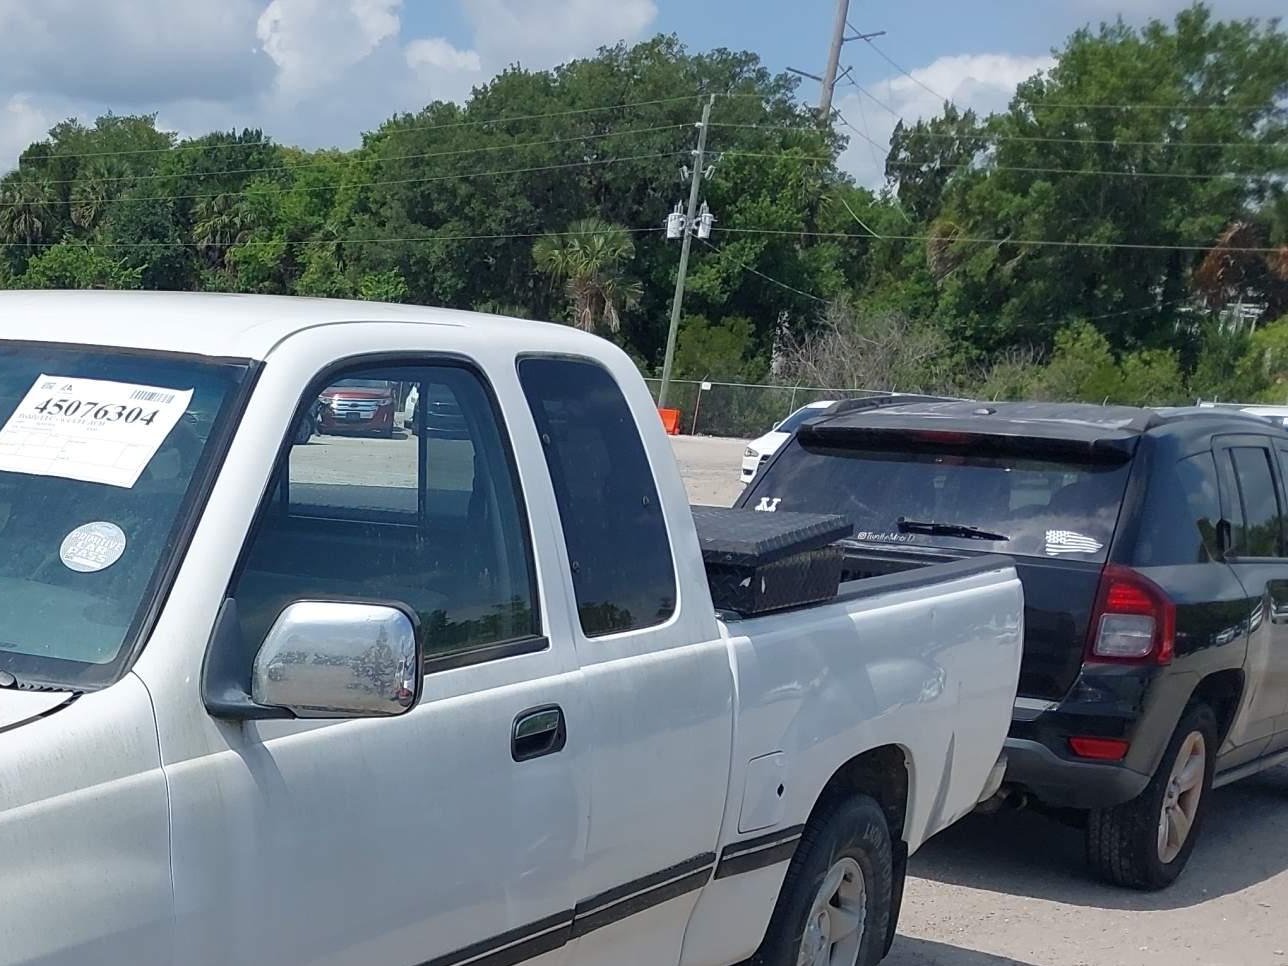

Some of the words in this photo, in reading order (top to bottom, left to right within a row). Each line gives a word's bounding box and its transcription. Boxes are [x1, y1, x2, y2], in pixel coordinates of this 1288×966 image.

[34, 397, 160, 426] 45076304
[66, 546, 107, 563] PASS
[76, 541, 107, 555] CAR
